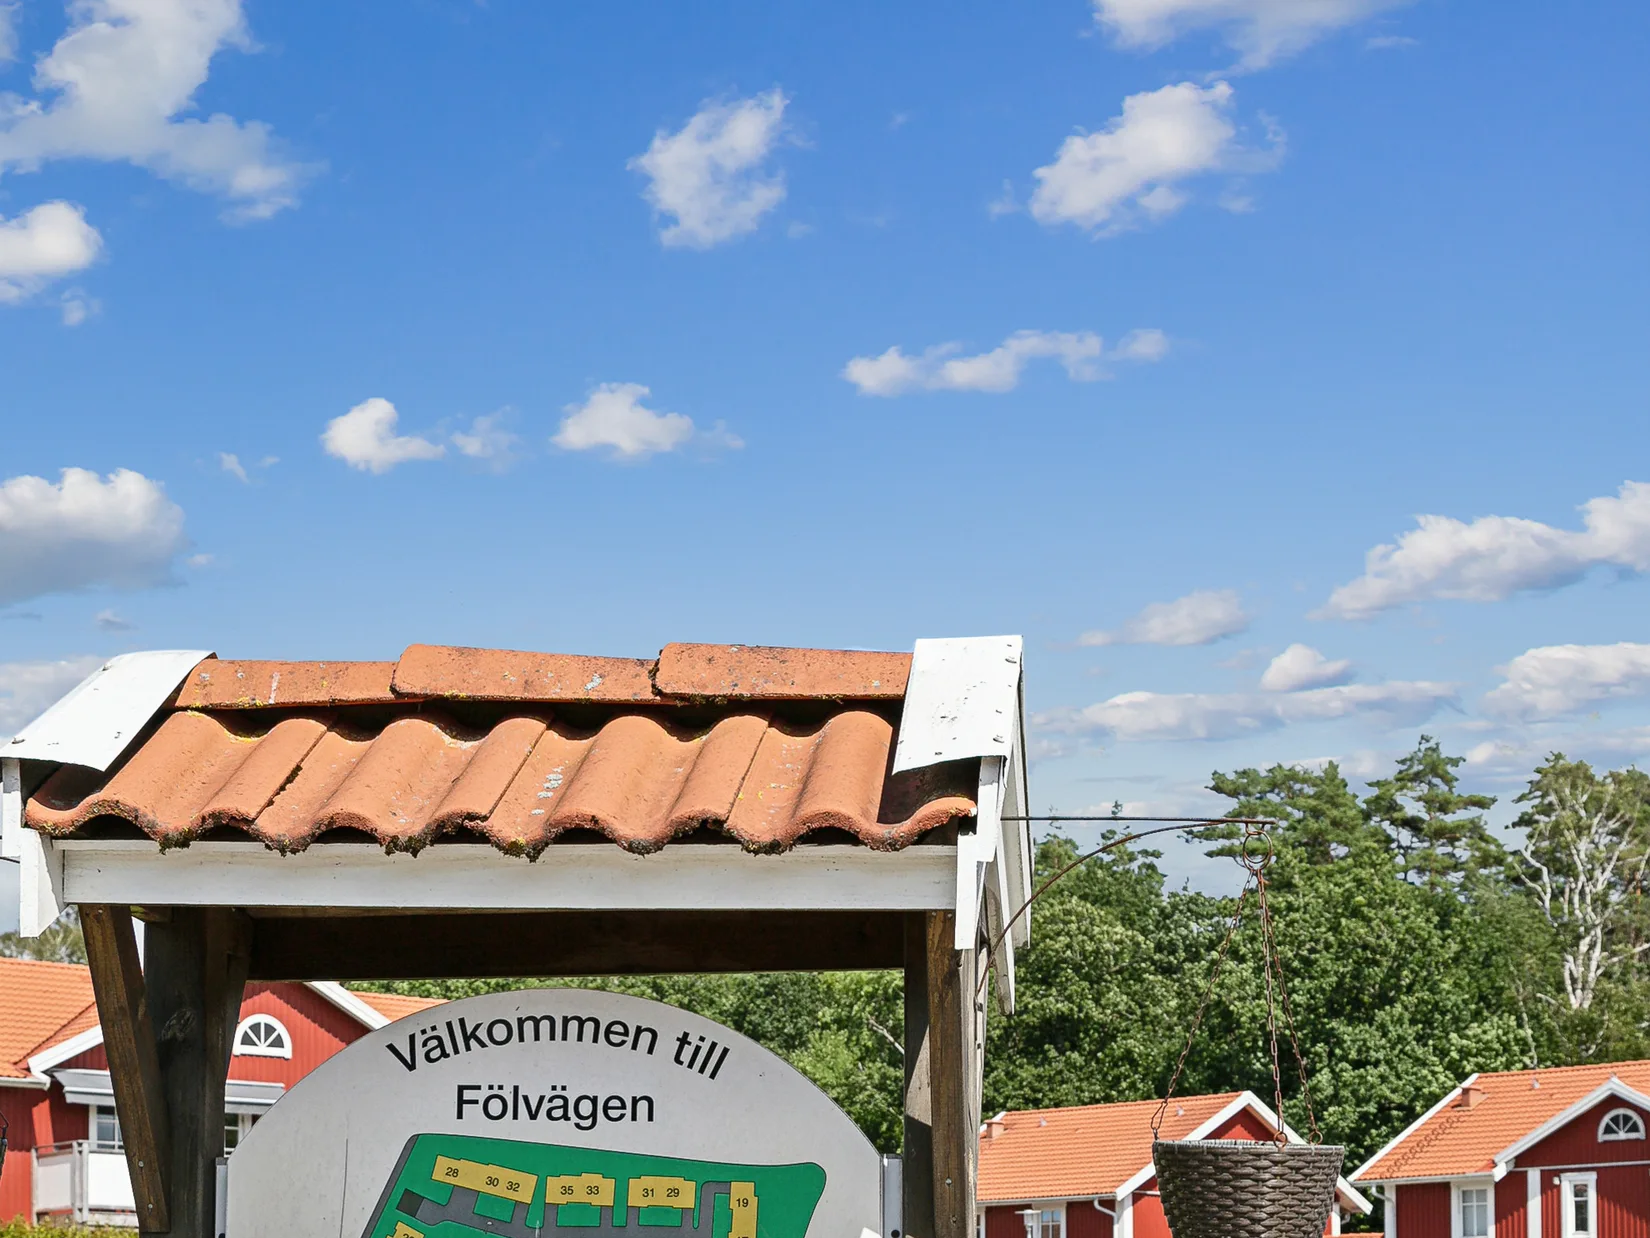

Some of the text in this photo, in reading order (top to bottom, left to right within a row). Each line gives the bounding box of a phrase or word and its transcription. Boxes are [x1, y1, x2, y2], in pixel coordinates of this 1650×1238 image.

[385, 1014, 731, 1081] Välkommen till
[457, 1085, 653, 1130] Fölvägen
[444, 1166, 460, 1178] 28
[485, 1175, 521, 1193] 30 32
[560, 1185, 600, 1196] 35 33
[642, 1187, 680, 1198] 31 29
[735, 1197, 749, 1208] 19
